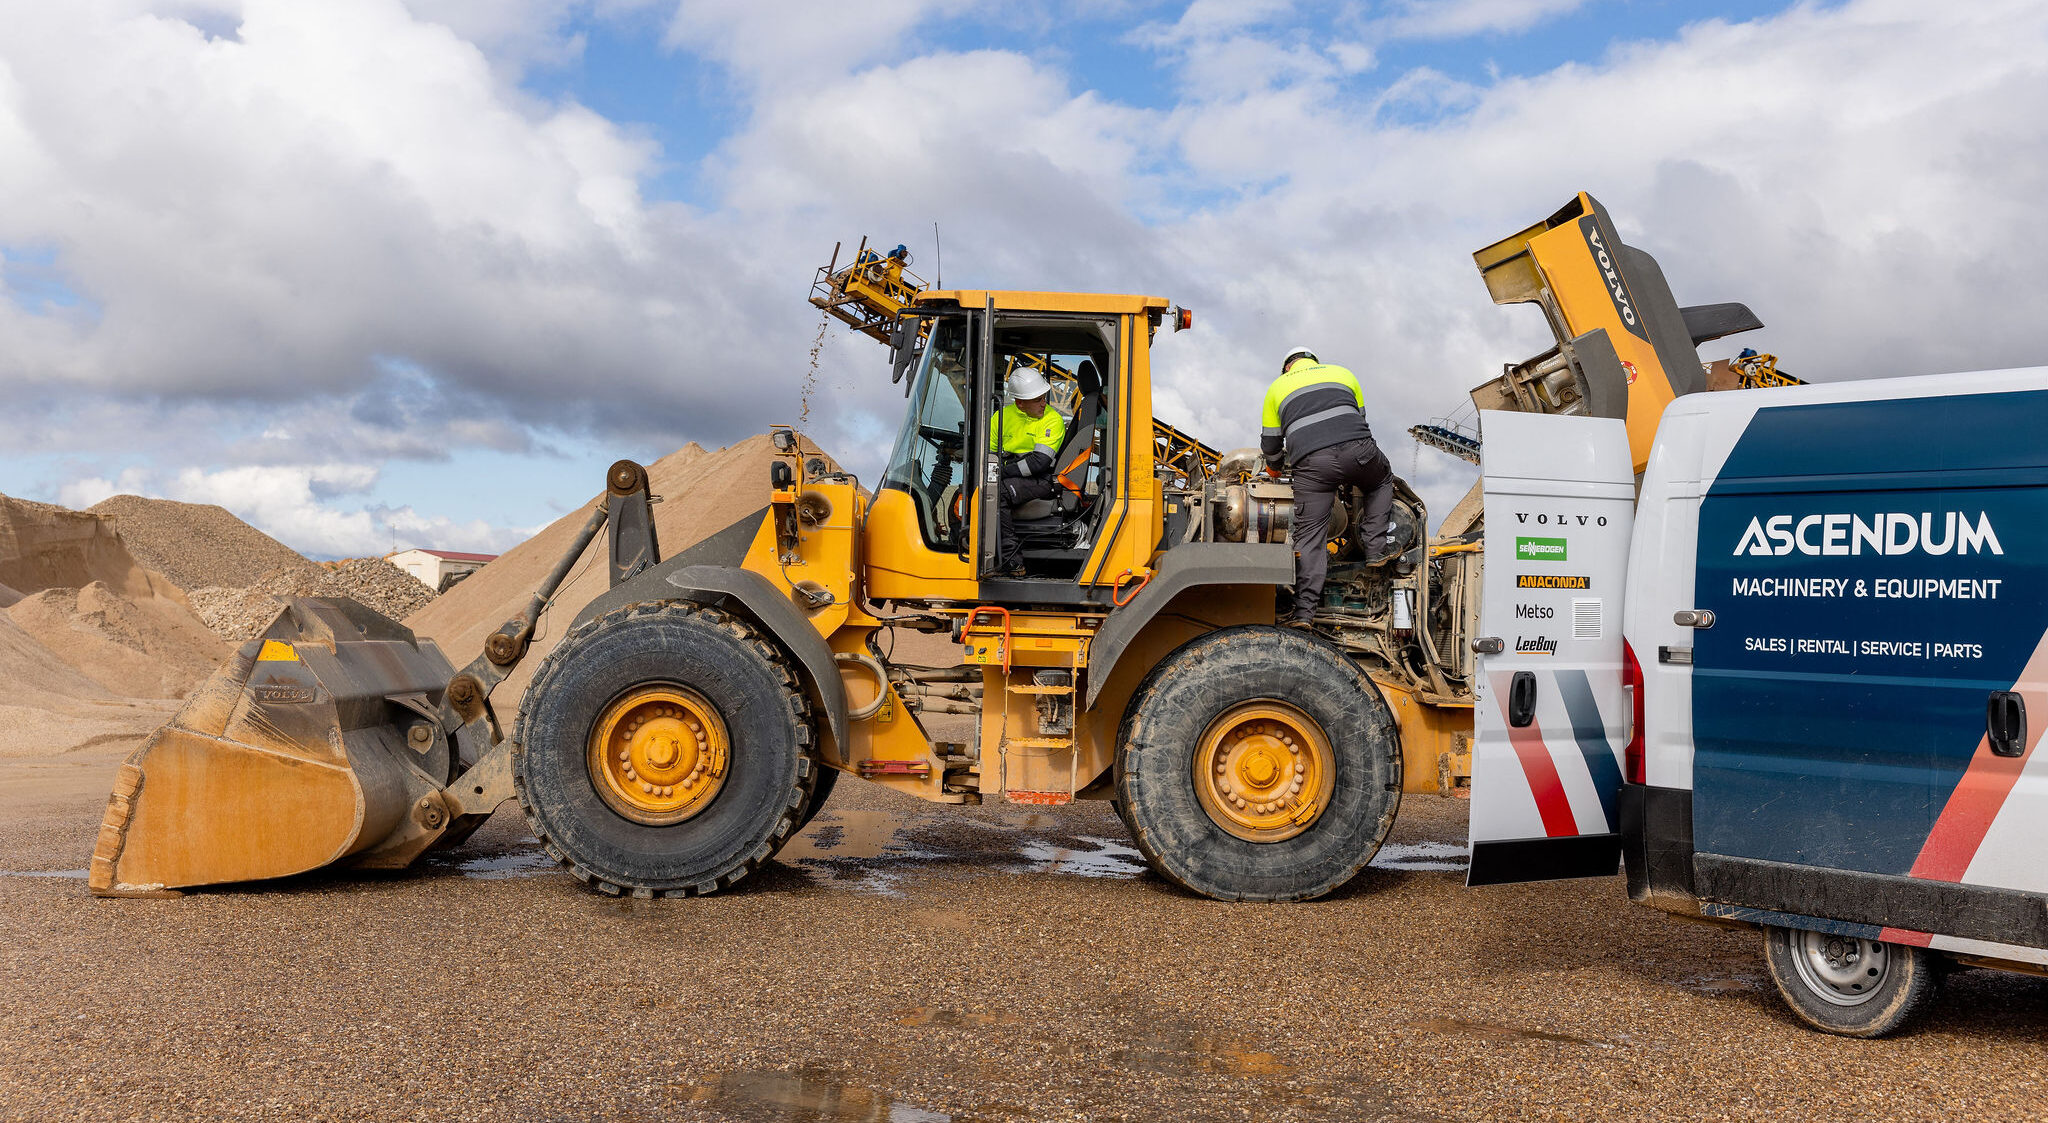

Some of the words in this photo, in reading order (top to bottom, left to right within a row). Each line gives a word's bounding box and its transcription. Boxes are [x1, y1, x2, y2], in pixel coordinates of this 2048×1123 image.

[1590, 226, 1635, 326] VOLVO
[1515, 513, 1608, 527] VOLVO
[1732, 510, 2004, 556] ASCENDUM
[1519, 541, 1565, 556] SENNEBOGEN
[1519, 575, 1586, 589] ANACONDA
[1732, 578, 1849, 597] MACHINERY
[1853, 579, 1869, 598] &
[1874, 578, 2002, 599] EQUIPMENT
[1515, 603, 1554, 619] Metso
[1515, 635, 1558, 656] LeeBoy
[1745, 637, 1787, 652] SALES
[1797, 639, 1850, 654] RENTAL
[1861, 641, 1922, 657] SERVICE
[1934, 643, 1983, 659] PARTS
